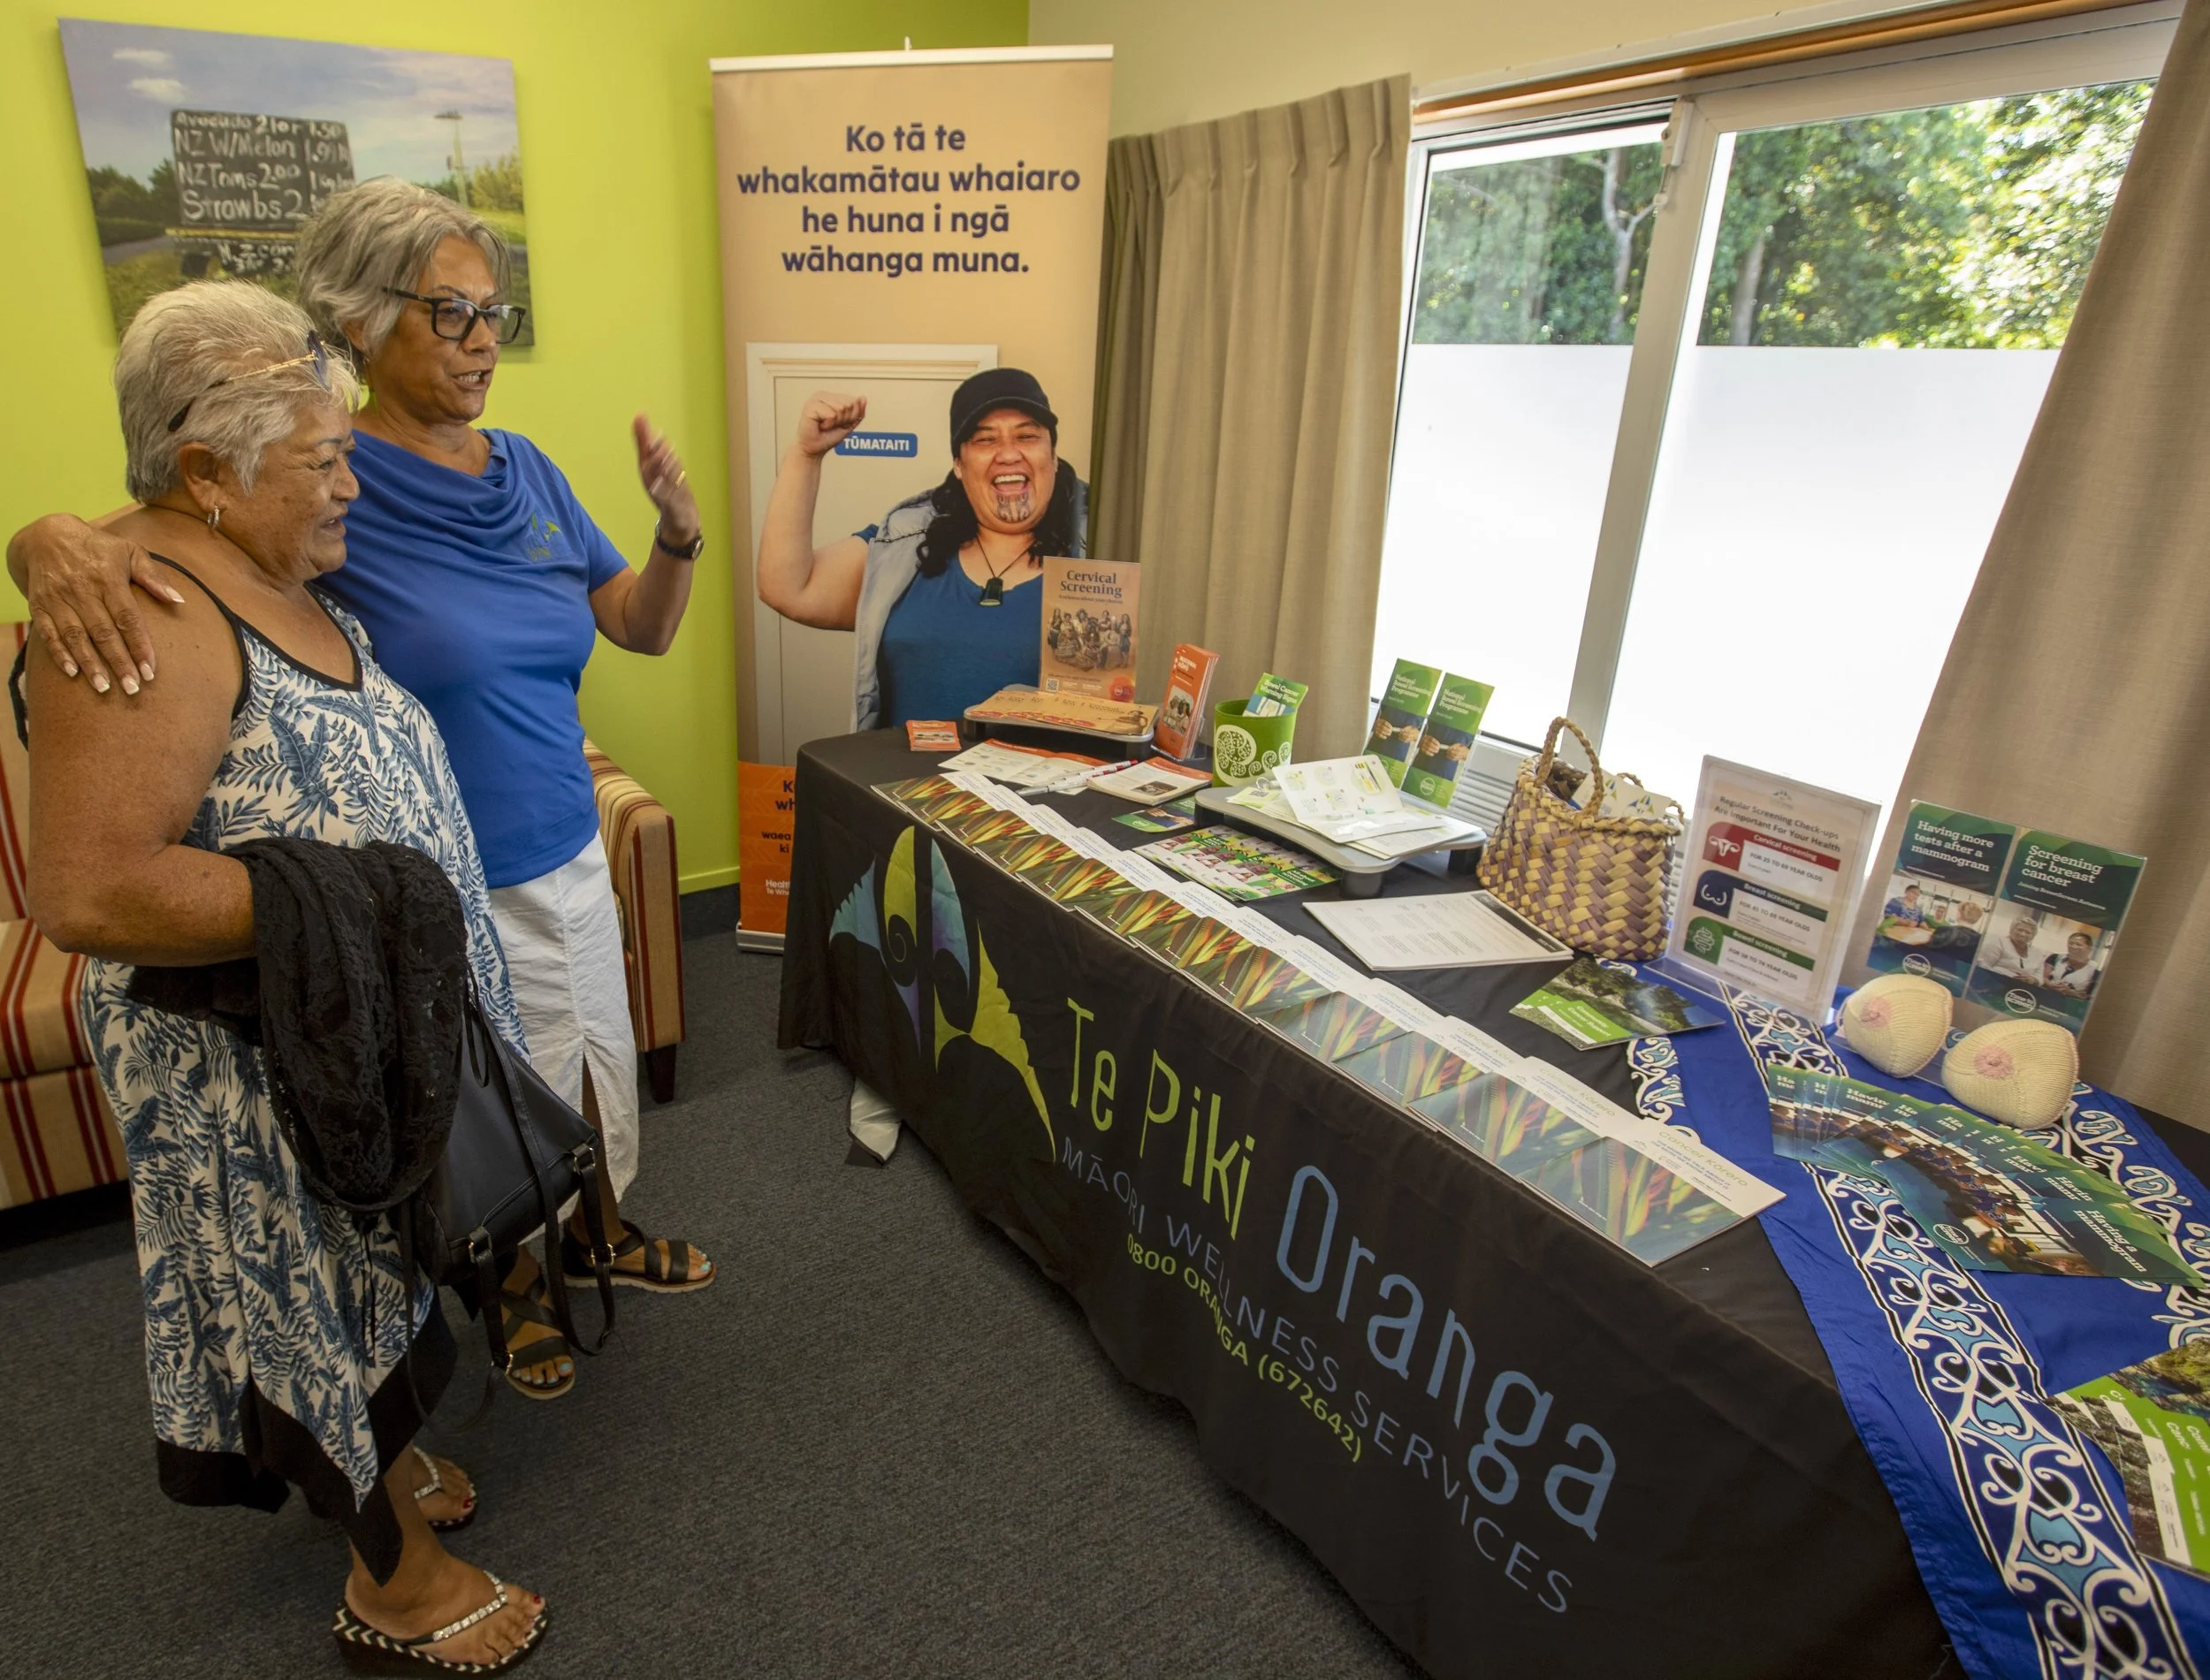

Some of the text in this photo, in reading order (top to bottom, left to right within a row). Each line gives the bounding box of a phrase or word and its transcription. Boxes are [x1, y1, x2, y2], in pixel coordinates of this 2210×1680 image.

[173, 127, 206, 157] NZ
[846, 123, 966, 152] Ko tā te
[178, 162, 209, 187] NZ
[736, 160, 1081, 194] whakamātau whaiaro
[802, 202, 1010, 239] he huna i ngā
[781, 245, 1030, 277] wāhanga muna.
[843, 437, 910, 452] TŪMATAITI
[1061, 581, 1123, 598] Screening
[1067, 570, 1116, 584] Cervical
[1715, 806, 1840, 853] Are Important For Your Health
[1720, 796, 1840, 840] Regular Screening Check-ups
[1754, 834, 1818, 862] Cervical screening
[1914, 832, 1942, 846] tests
[1944, 841, 1974, 855] after
[1917, 820, 1994, 848] Having more
[780, 844, 789, 854] ki
[1911, 845, 1990, 872] mammogram
[2029, 845, 2104, 875] Screening
[1750, 852, 1762, 861] FOR
[1789, 864, 1805, 876] YEAR
[1806, 871, 1824, 882] OLDS
[2022, 868, 2071, 886] cancer
[2024, 855, 2096, 883] for breast
[1743, 883, 1802, 910] Breast screening
[1778, 914, 1795, 925] YEAR
[1795, 921, 1811, 932] OLDS
[1733, 931, 1755, 943] Bowel
[1755, 938, 1788, 959] screening
[1766, 961, 1782, 973] YEAR
[1782, 968, 1798, 980] OLDS
[1659, 1131, 1704, 1159] Cancer
[2073, 1210, 2147, 1273] mammogram
[2086, 1210, 2133, 1247] Having
[1067, 998, 1618, 1542] Te Piki Oranga
[1127, 1233, 1362, 1463] 0800 ORANGA (672642)
[1063, 1136, 1574, 1614] MĀORI WELLNESS SERVICES
